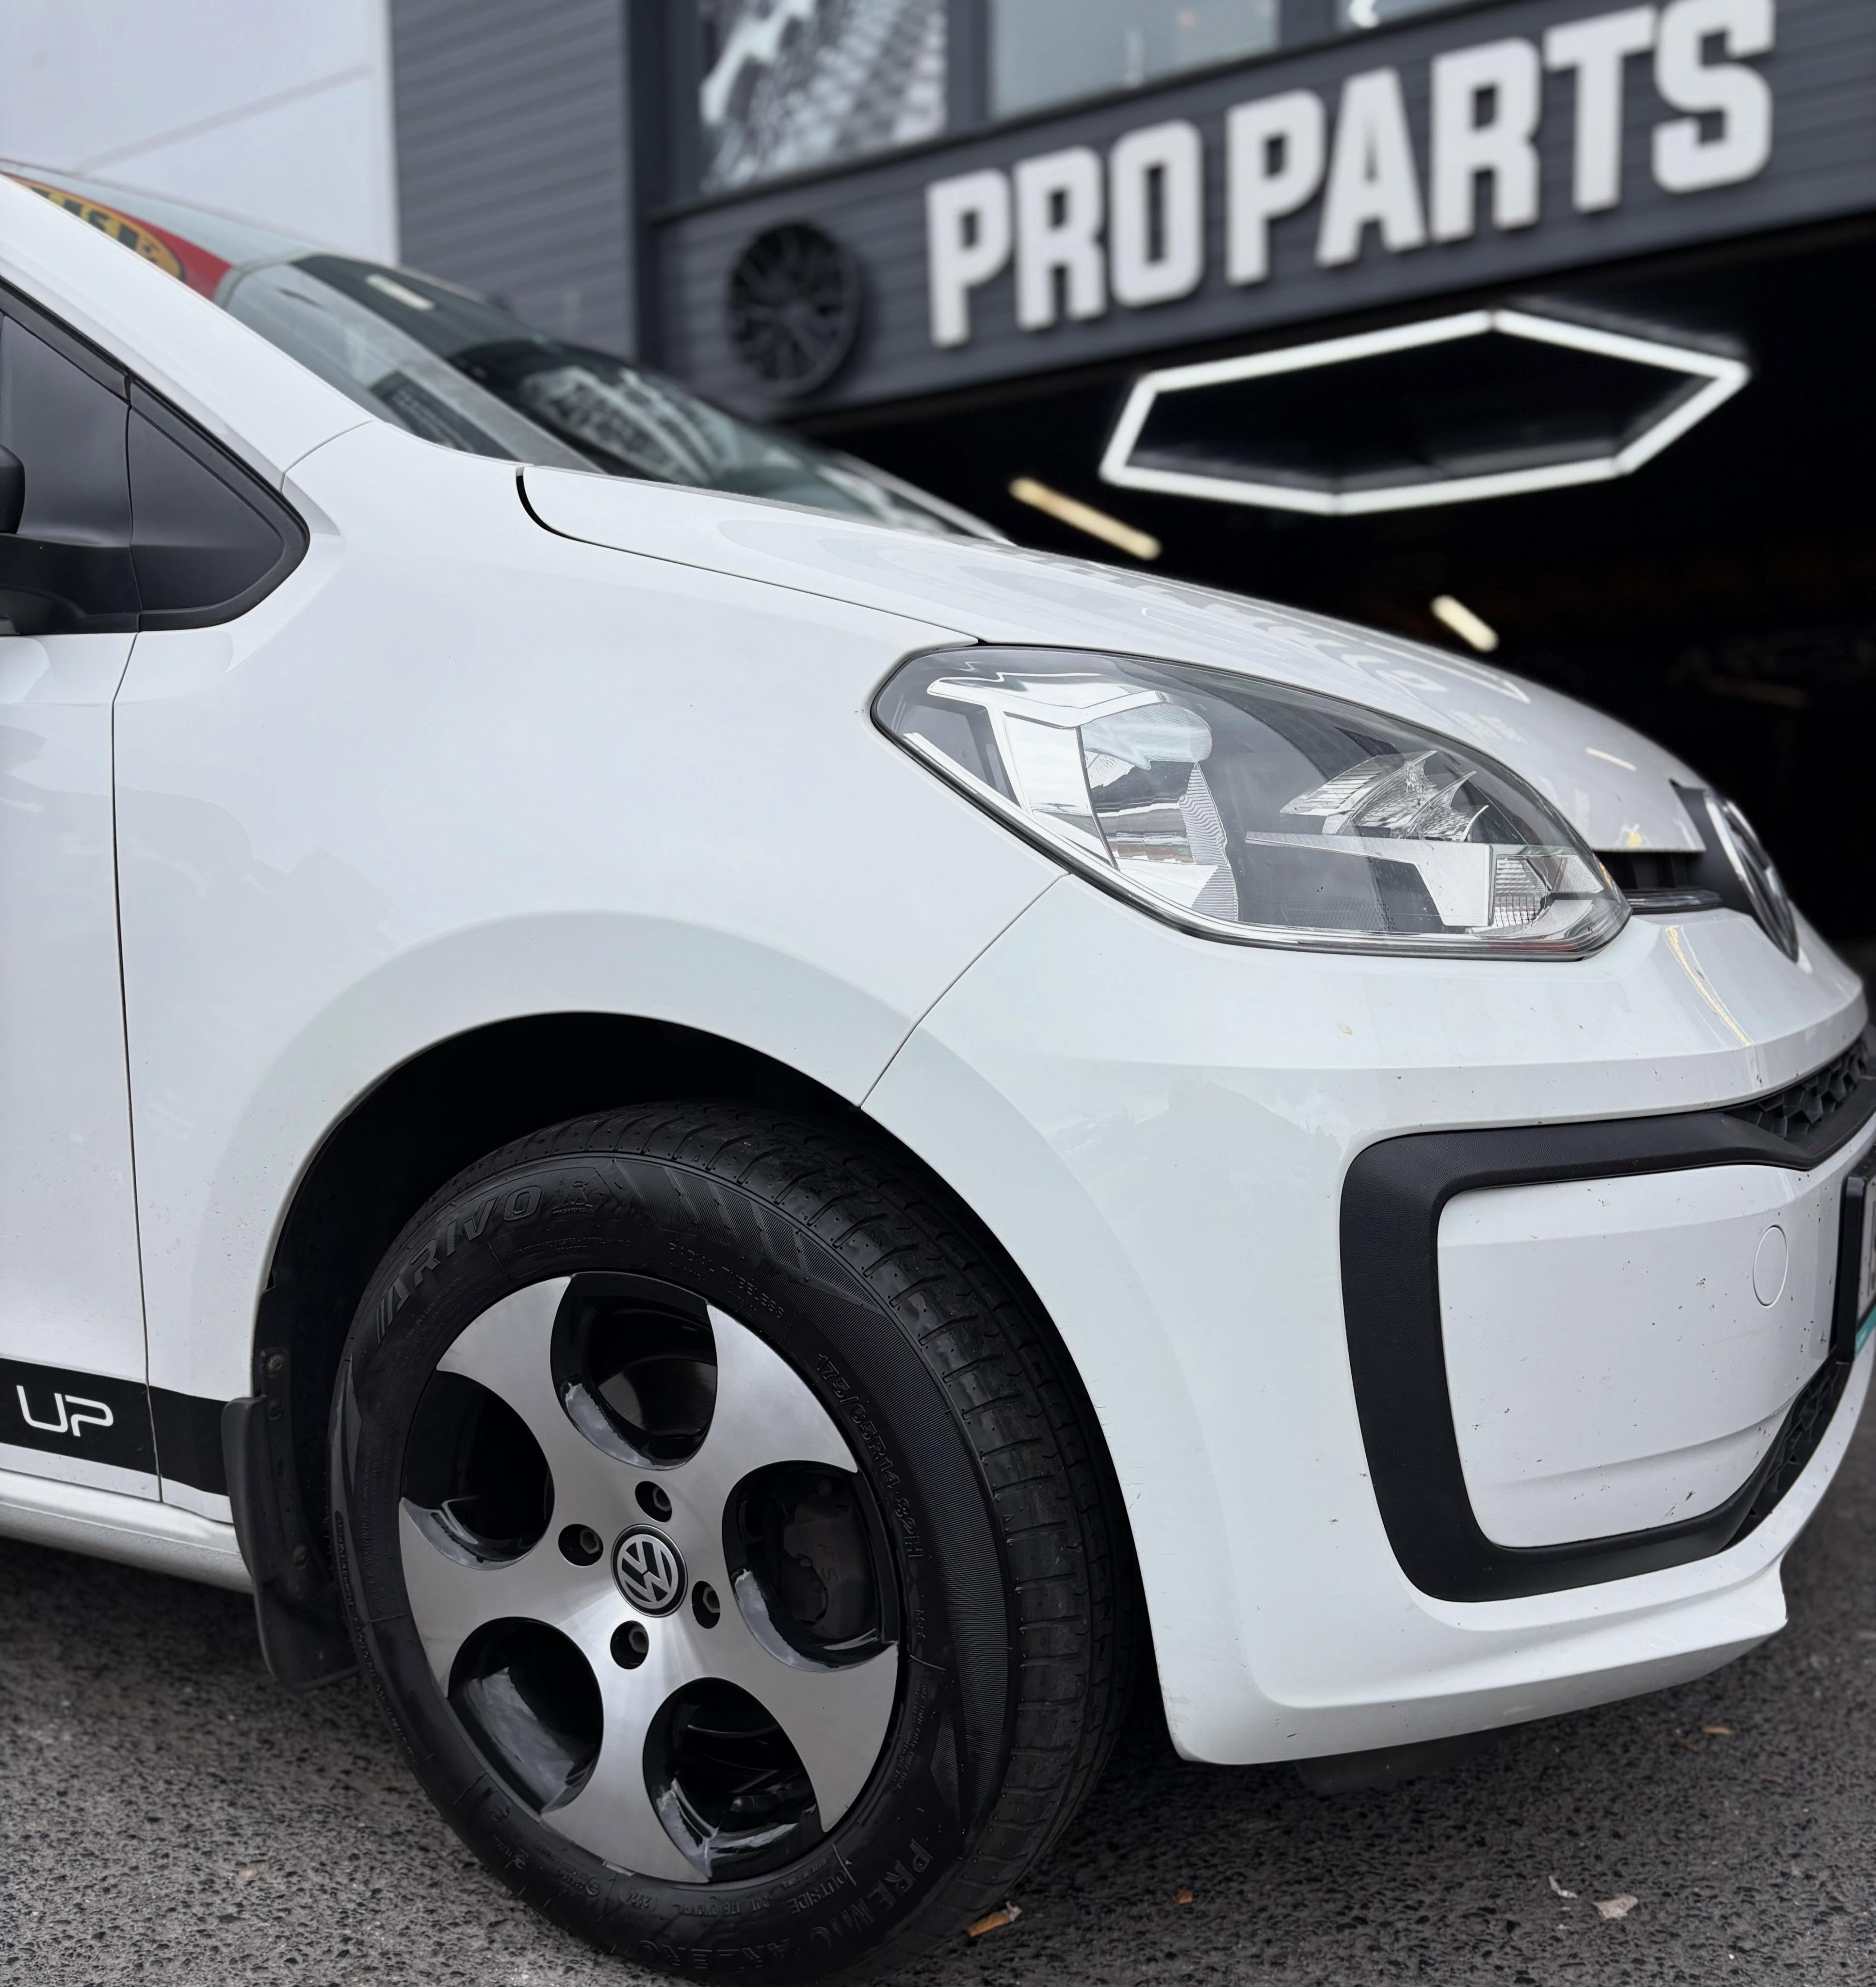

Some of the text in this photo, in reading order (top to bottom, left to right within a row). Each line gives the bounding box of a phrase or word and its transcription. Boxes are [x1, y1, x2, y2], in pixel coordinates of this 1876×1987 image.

[925, 0, 1775, 348] PRO PARTS
[376, 1185, 543, 1346] ARIVO
[16, 1384, 113, 1437] UP
[816, 1352, 924, 1558] 175/65R14 82H
[787, 1869, 847, 1914] OUTSIDE
